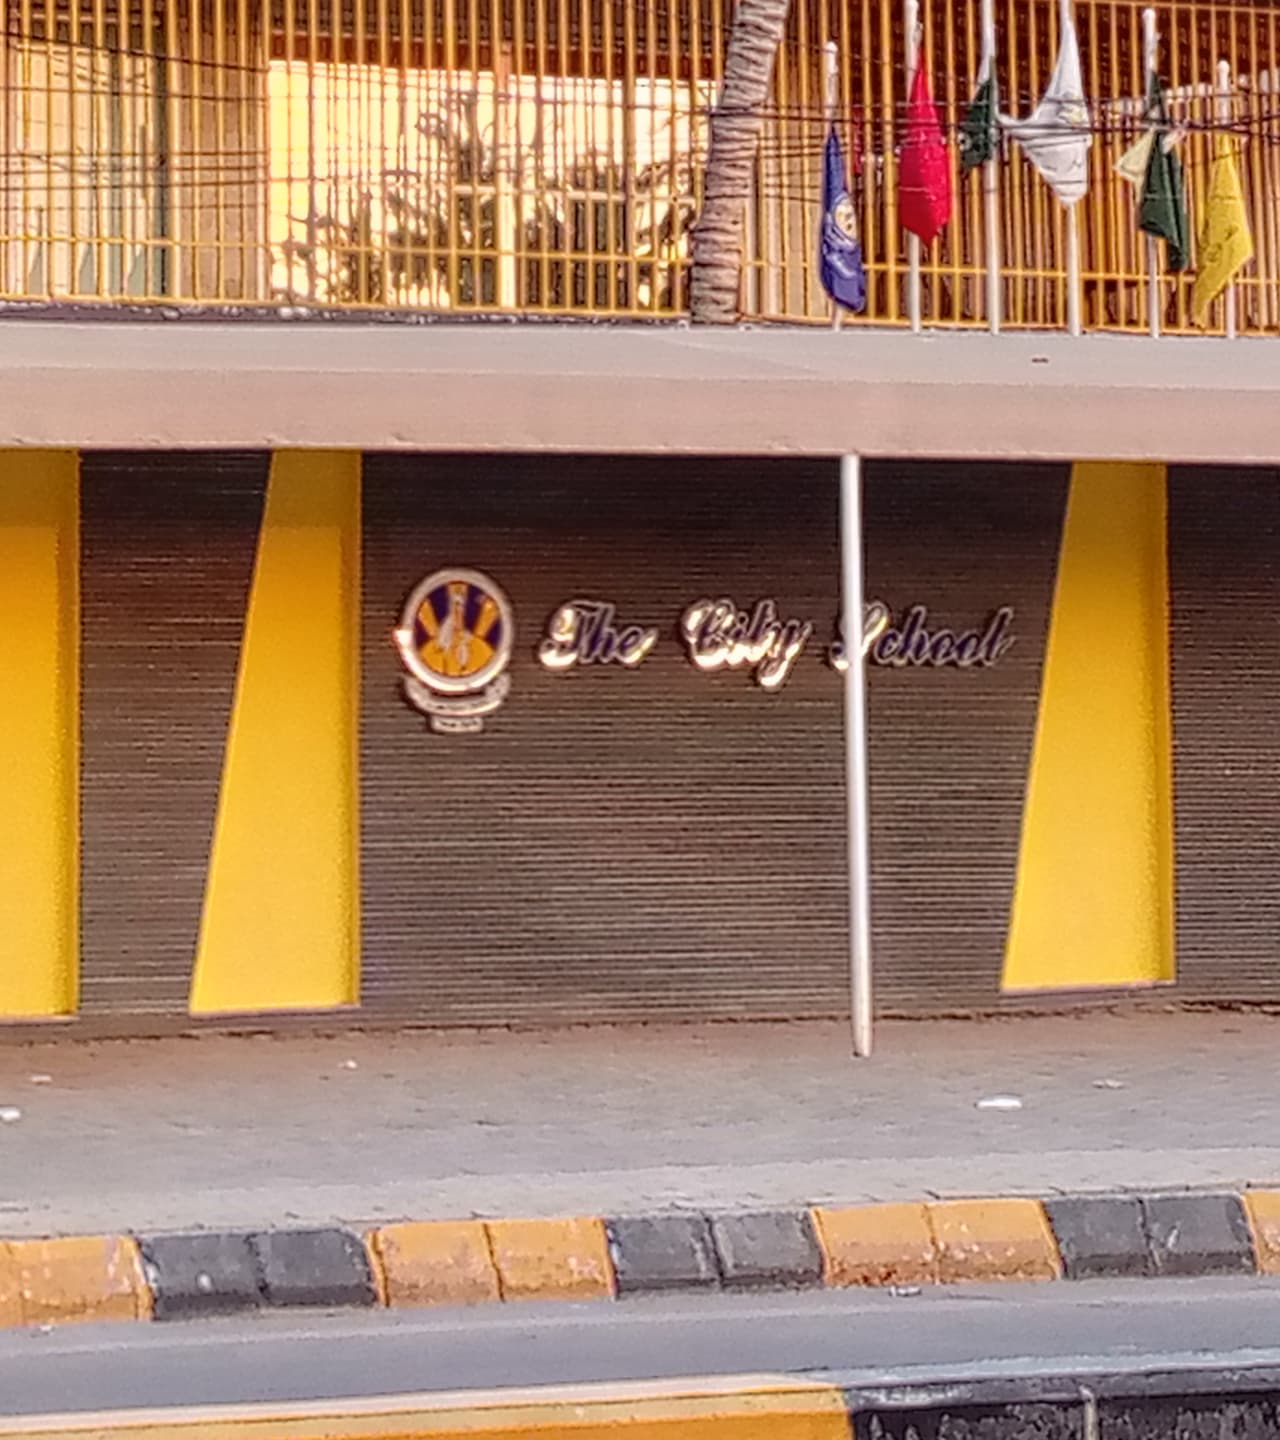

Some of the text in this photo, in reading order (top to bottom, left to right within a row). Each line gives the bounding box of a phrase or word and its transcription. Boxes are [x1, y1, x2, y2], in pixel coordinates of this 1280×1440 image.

[539, 599, 1016, 691] The City School
